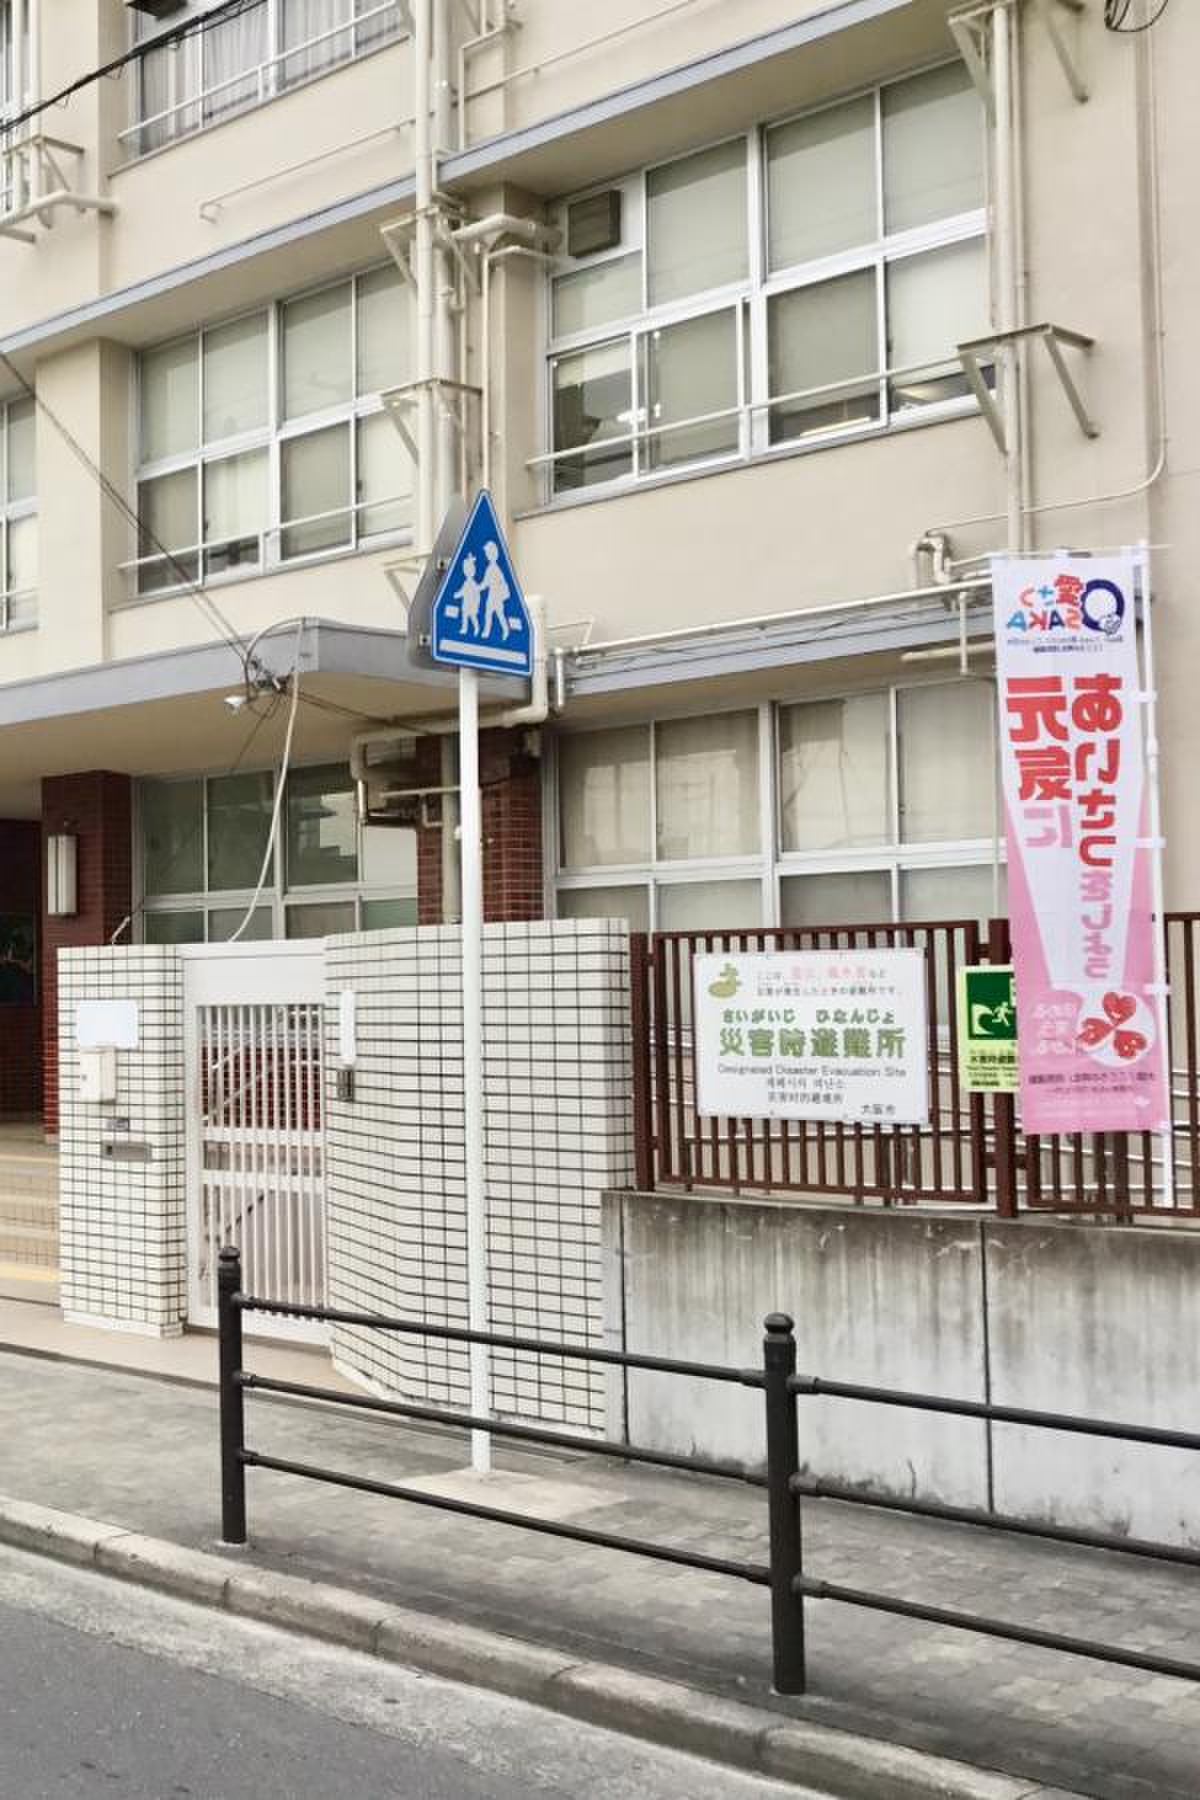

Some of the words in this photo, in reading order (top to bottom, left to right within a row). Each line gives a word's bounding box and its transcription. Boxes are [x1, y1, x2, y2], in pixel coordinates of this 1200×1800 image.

[722, 1008, 797, 1024] さいがいじ
[816, 1009, 896, 1025] ひなんじょ
[719, 1027, 907, 1059] 災害時避難所
[718, 1064, 772, 1077] Designated
[776, 1065, 818, 1076] Disaster
[822, 1066, 880, 1077] Evacuation
[884, 1067, 907, 1078] Site
